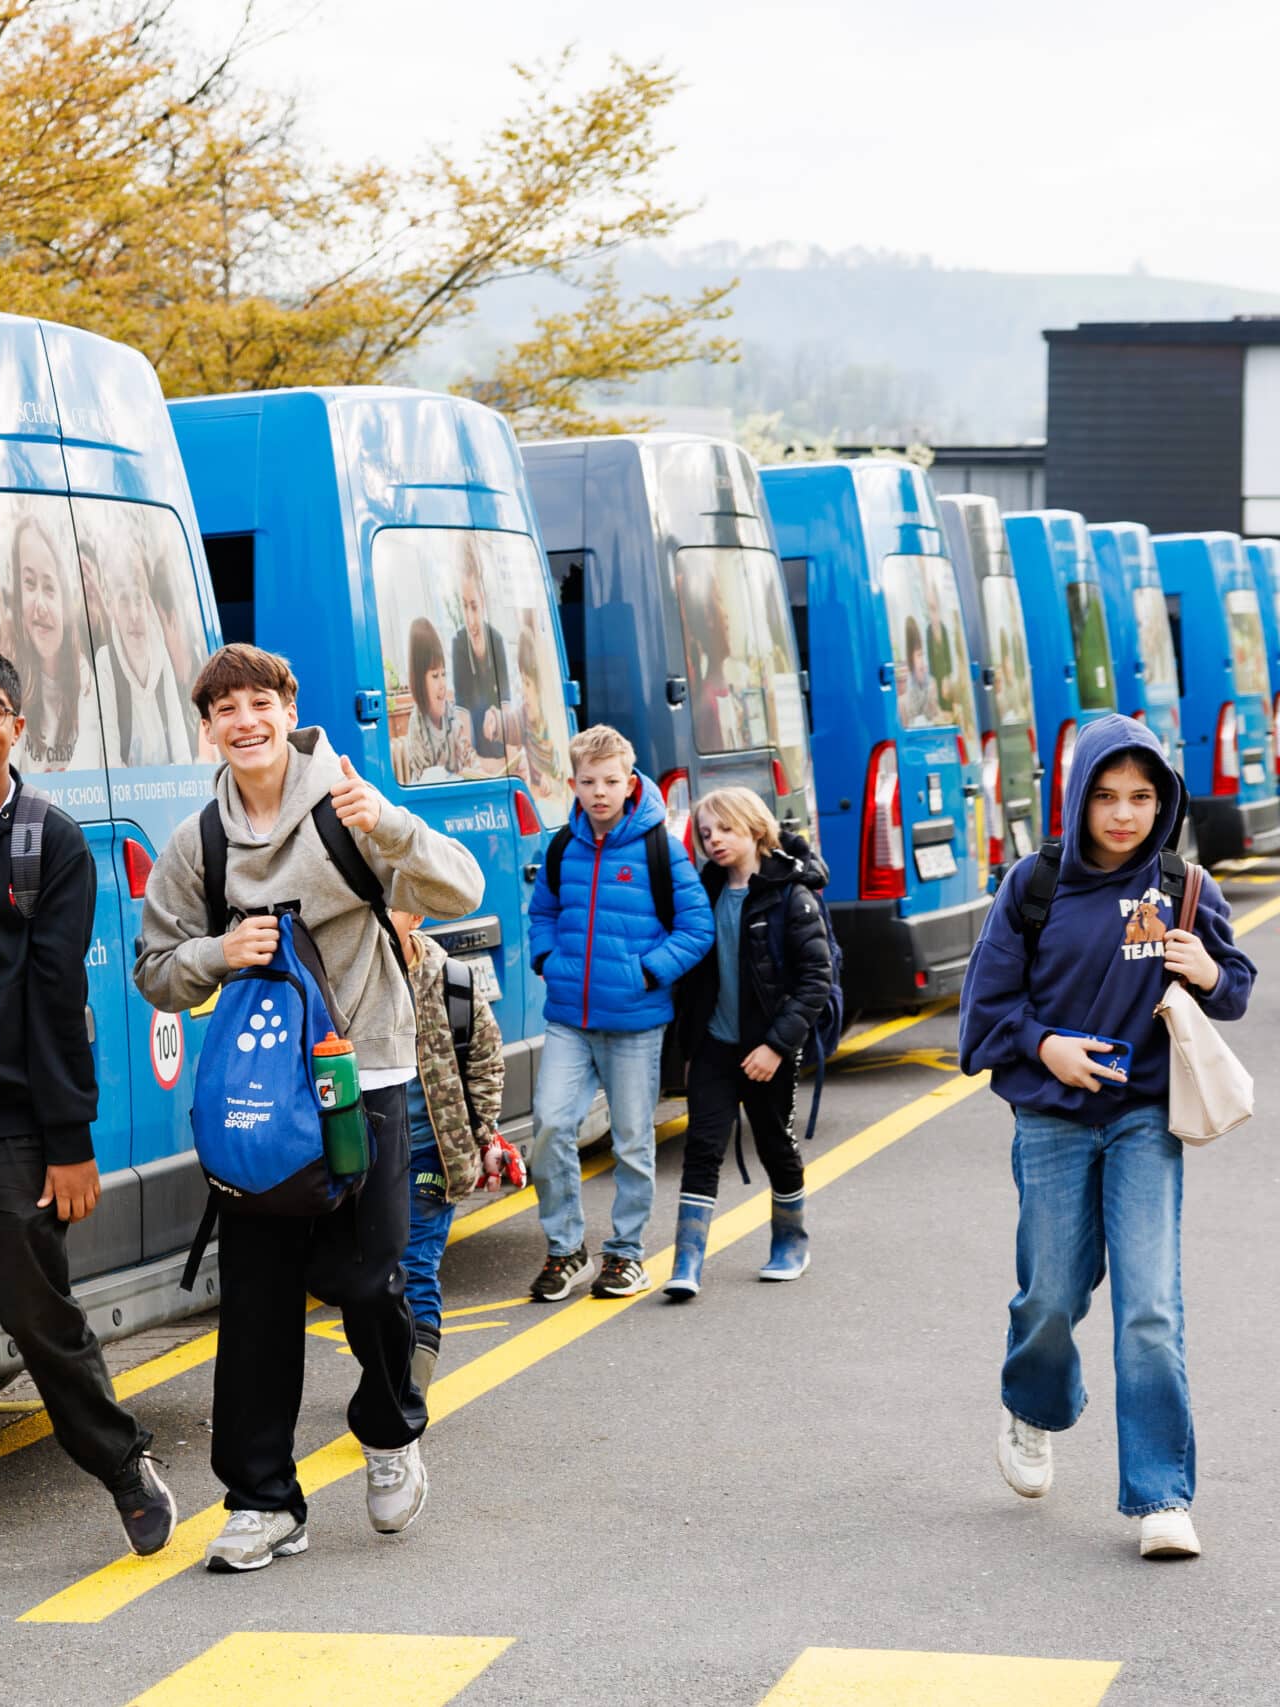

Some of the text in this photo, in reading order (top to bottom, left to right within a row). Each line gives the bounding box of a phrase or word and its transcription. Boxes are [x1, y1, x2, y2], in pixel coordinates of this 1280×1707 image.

[67, 785, 106, 806] SCHOOL
[112, 784, 131, 802] FOR
[134, 781, 177, 801] STUDENTS
[178, 780, 198, 797] AGED
[156, 1023, 178, 1061] 100
[224, 1119, 256, 1129] SPORT
